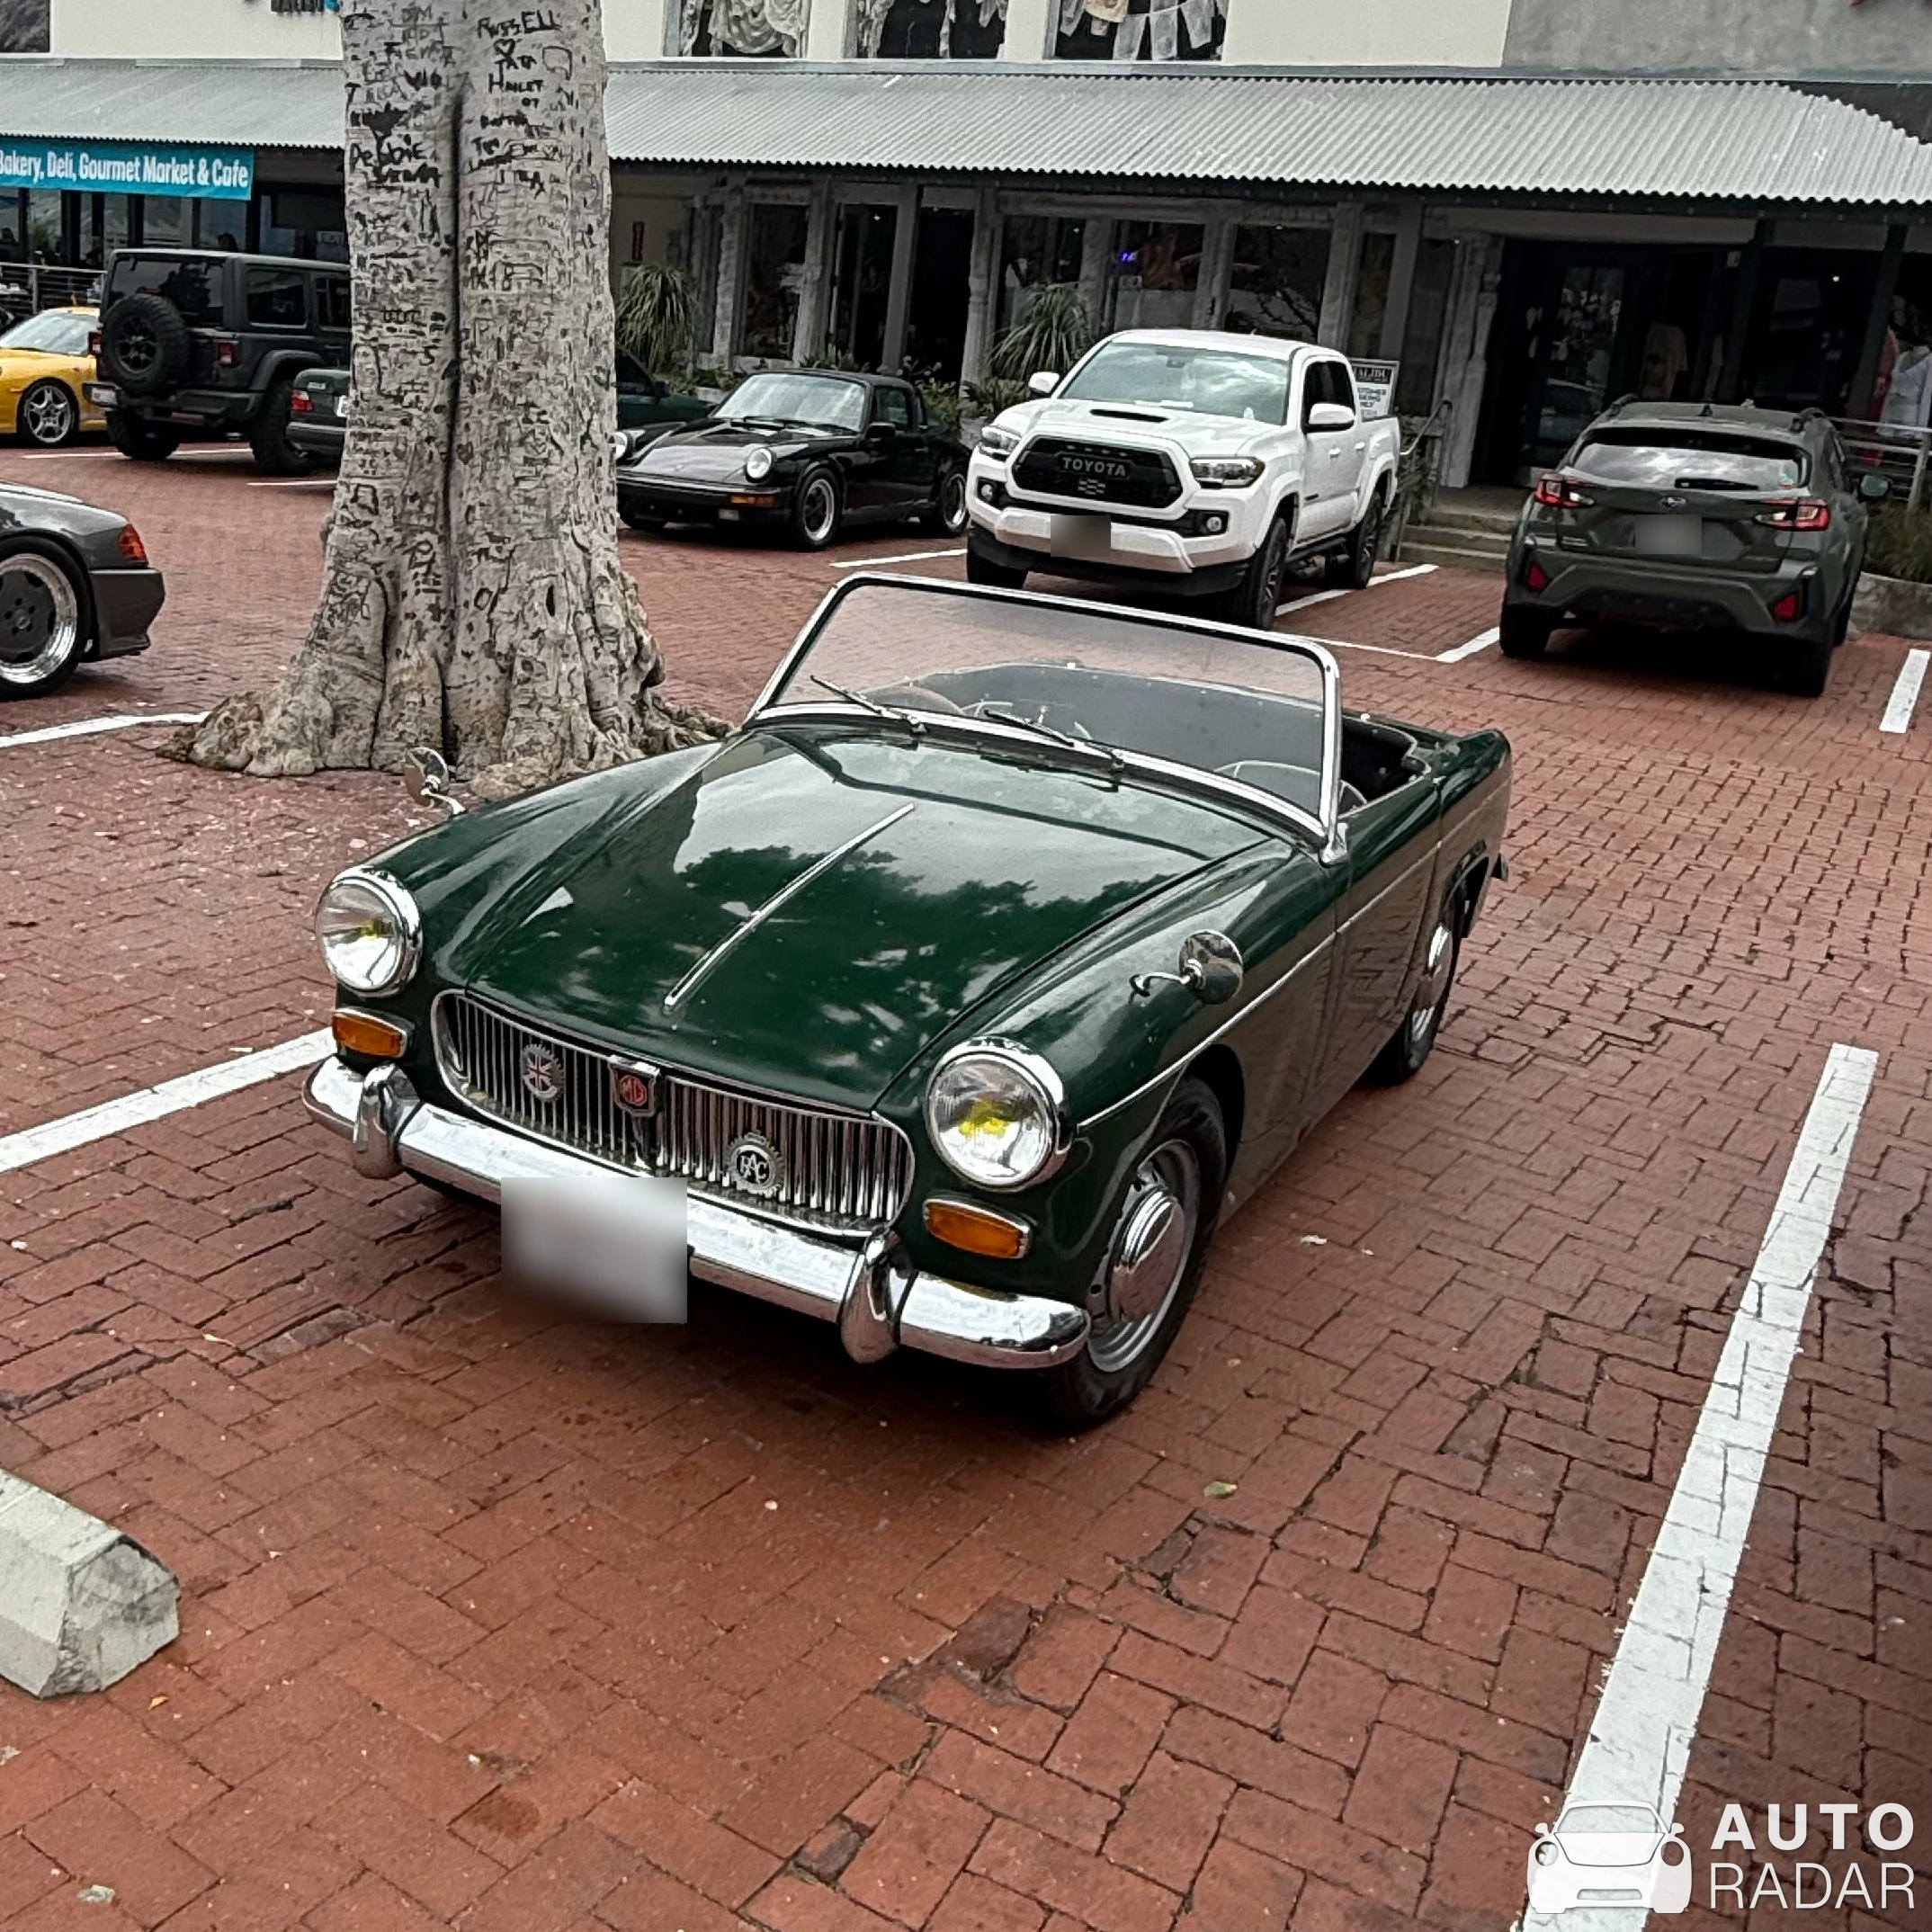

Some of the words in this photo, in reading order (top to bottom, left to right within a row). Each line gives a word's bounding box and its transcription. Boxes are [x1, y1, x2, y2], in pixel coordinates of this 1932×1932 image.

[47, 150, 77, 182] Deli,
[79, 152, 140, 183] Gourmet
[142, 155, 195, 185] Market
[197, 157, 210, 186] &
[211, 158, 248, 188] Cafe
[1062, 457, 1126, 476] TOYOTA
[622, 1078, 645, 1103] MG
[739, 1153, 768, 1185] RAC
